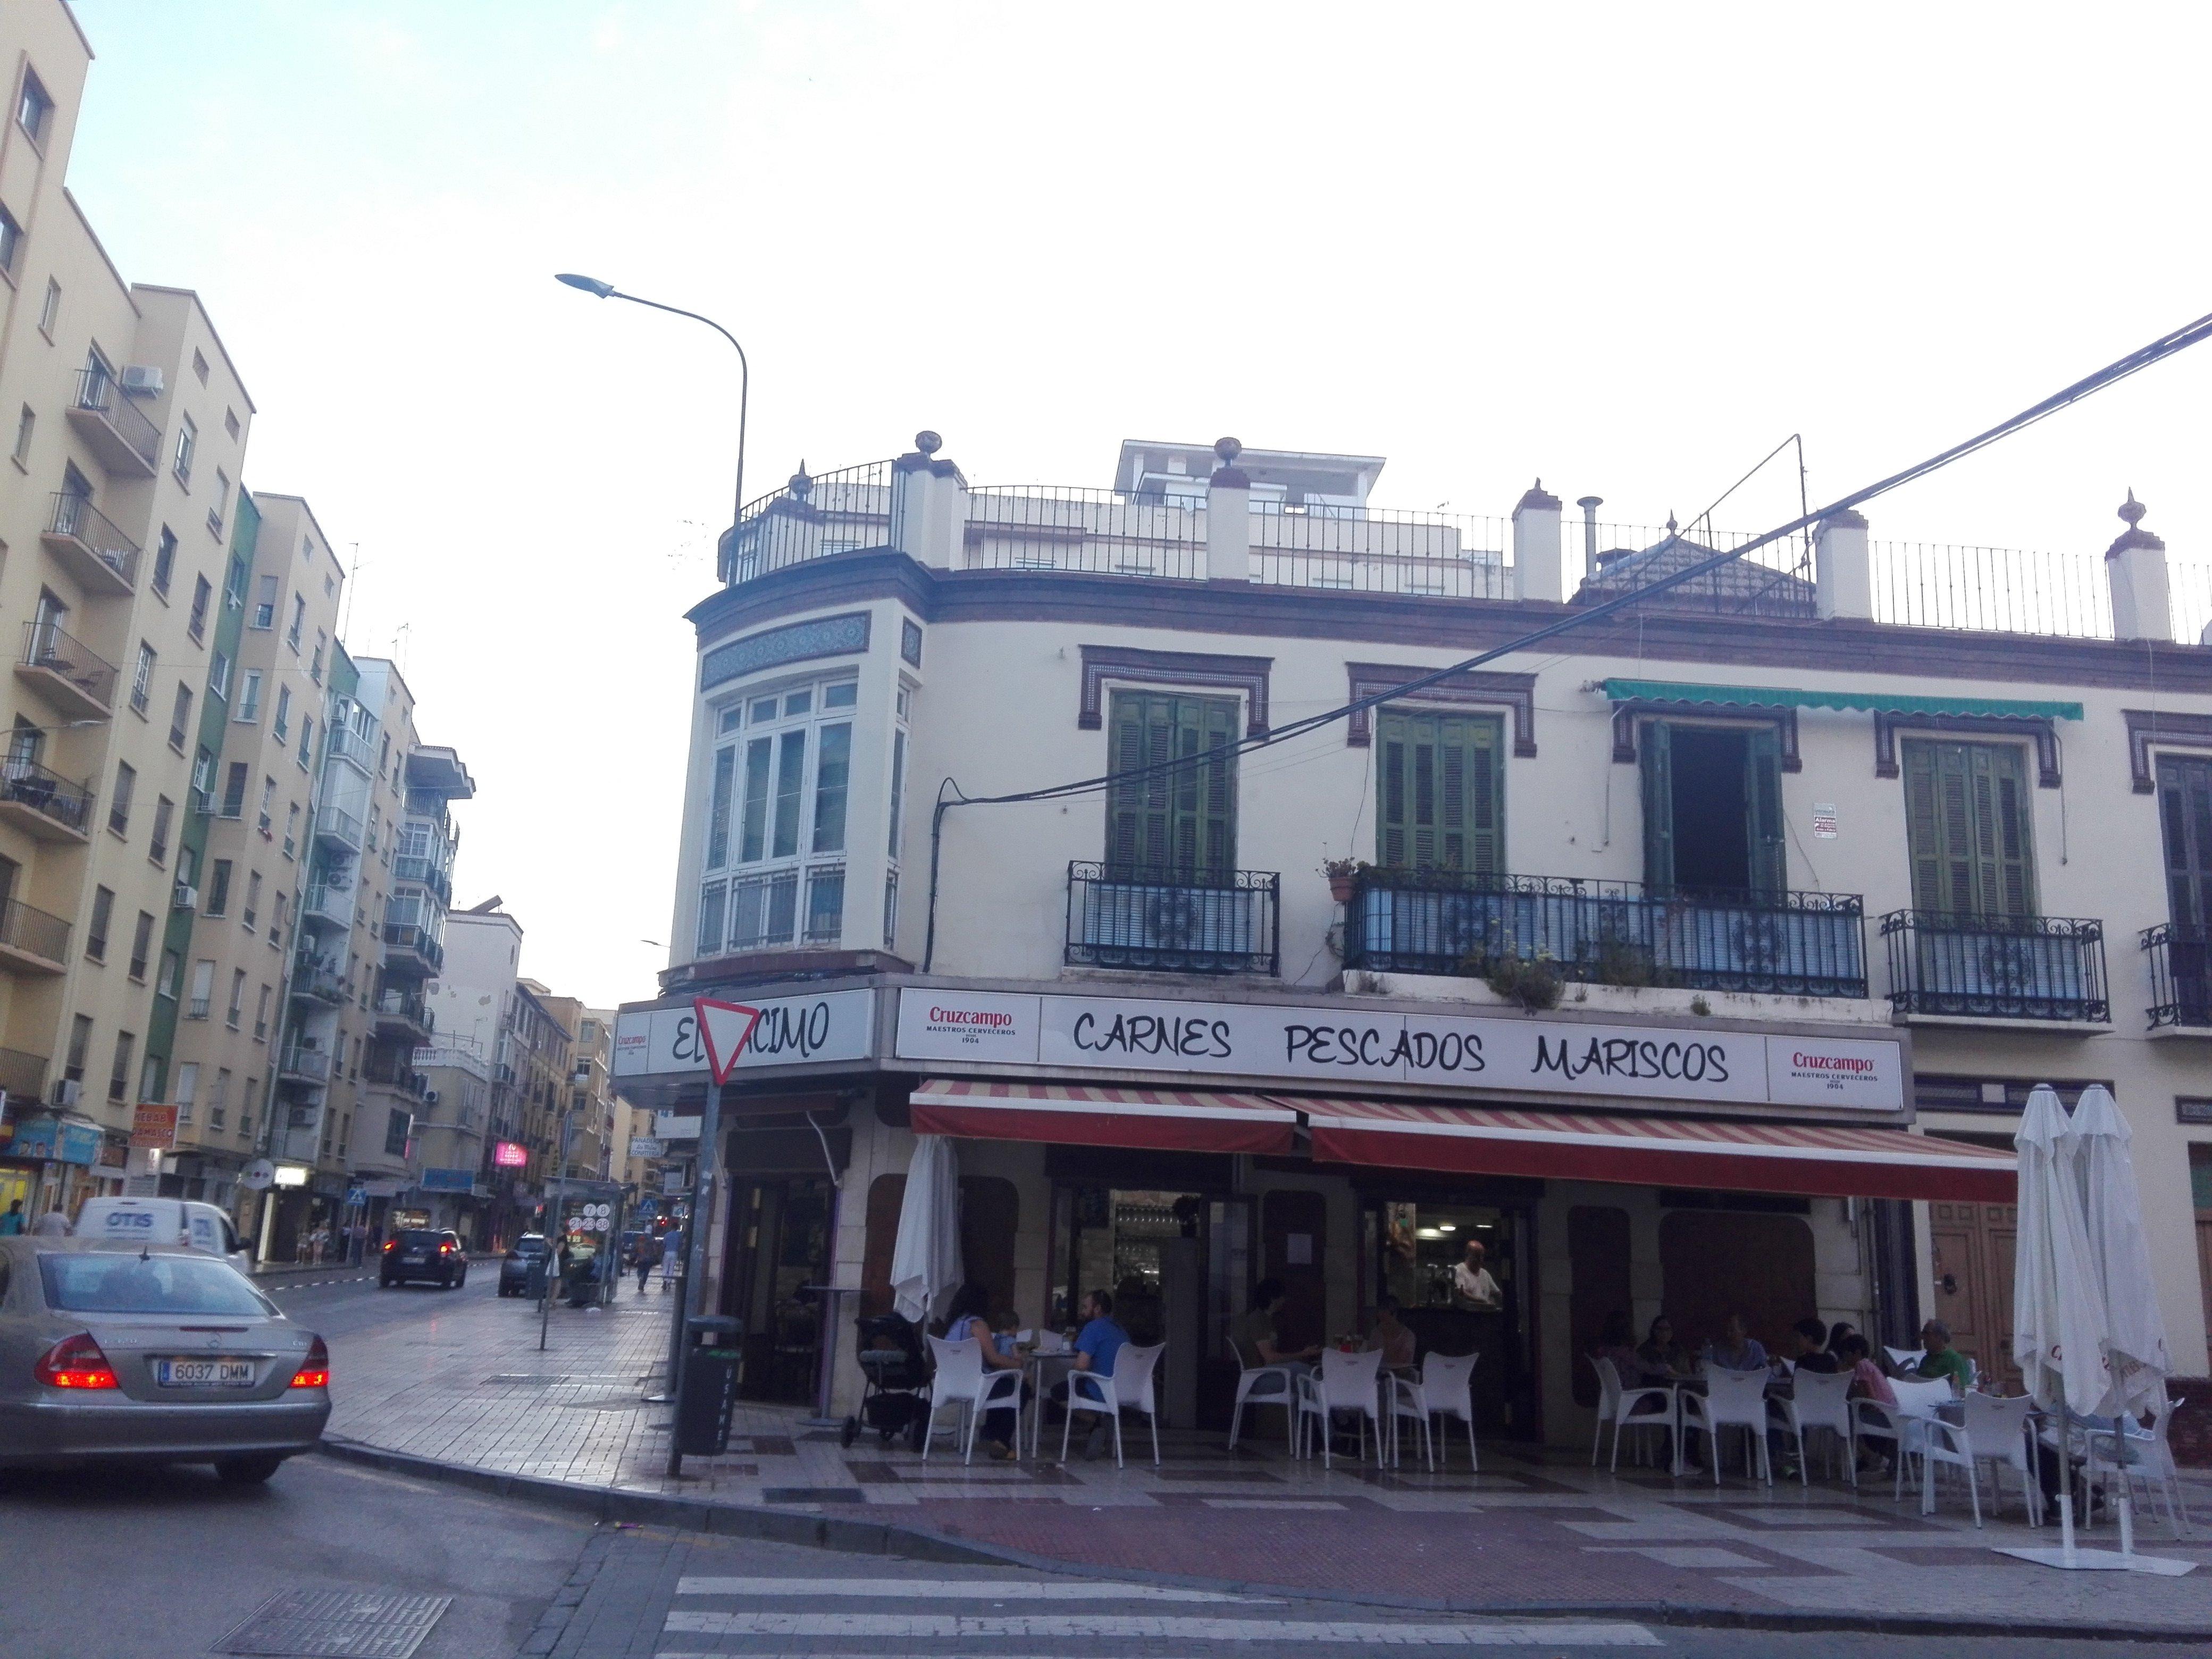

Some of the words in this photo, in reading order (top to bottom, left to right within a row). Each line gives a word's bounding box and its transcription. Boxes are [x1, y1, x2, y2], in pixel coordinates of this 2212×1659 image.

[930, 1007, 1012, 1028] Cruzcampo
[746, 1002, 829, 1058] CIMO
[618, 1036, 646, 1045] Cruzcampo
[1074, 1012, 1231, 1057] CARNES
[1284, 1025, 1485, 1071] PESCADOS
[1530, 1034, 1729, 1083] MARISCOS
[1793, 1052, 1873, 1074] Cruzcampo
[587, 1205, 593, 1214] 7
[601, 1206, 607, 1215] 8
[597, 1220, 608, 1229] 38
[175, 1364, 213, 1379] 6037
[220, 1364, 248, 1380] DMM
